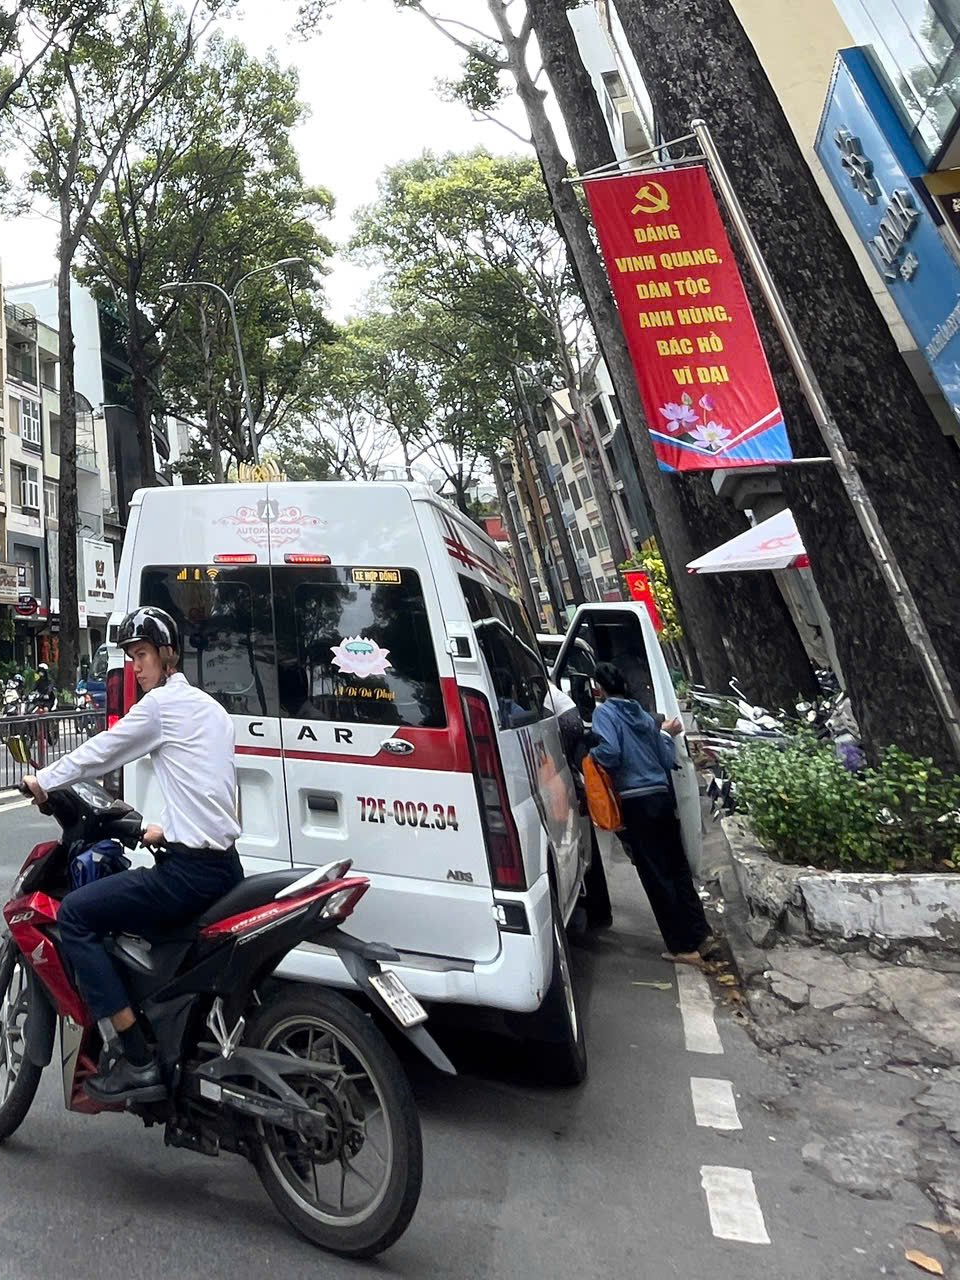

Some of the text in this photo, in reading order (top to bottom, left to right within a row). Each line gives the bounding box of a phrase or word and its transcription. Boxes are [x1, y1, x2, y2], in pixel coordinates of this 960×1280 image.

[634, 223, 681, 244] ĐẢNG
[615, 248, 723, 273] VINH QUANG,
[636, 277, 711, 300] DÂN TỘC
[638, 304, 733, 328] ANH HÙNG,
[655, 330, 723, 357] BÁC HỒ
[672, 365, 729, 386] VĨ ĐẠI
[355, 570, 364, 581] XE
[357, 796, 459, 831] 72F-002.34
